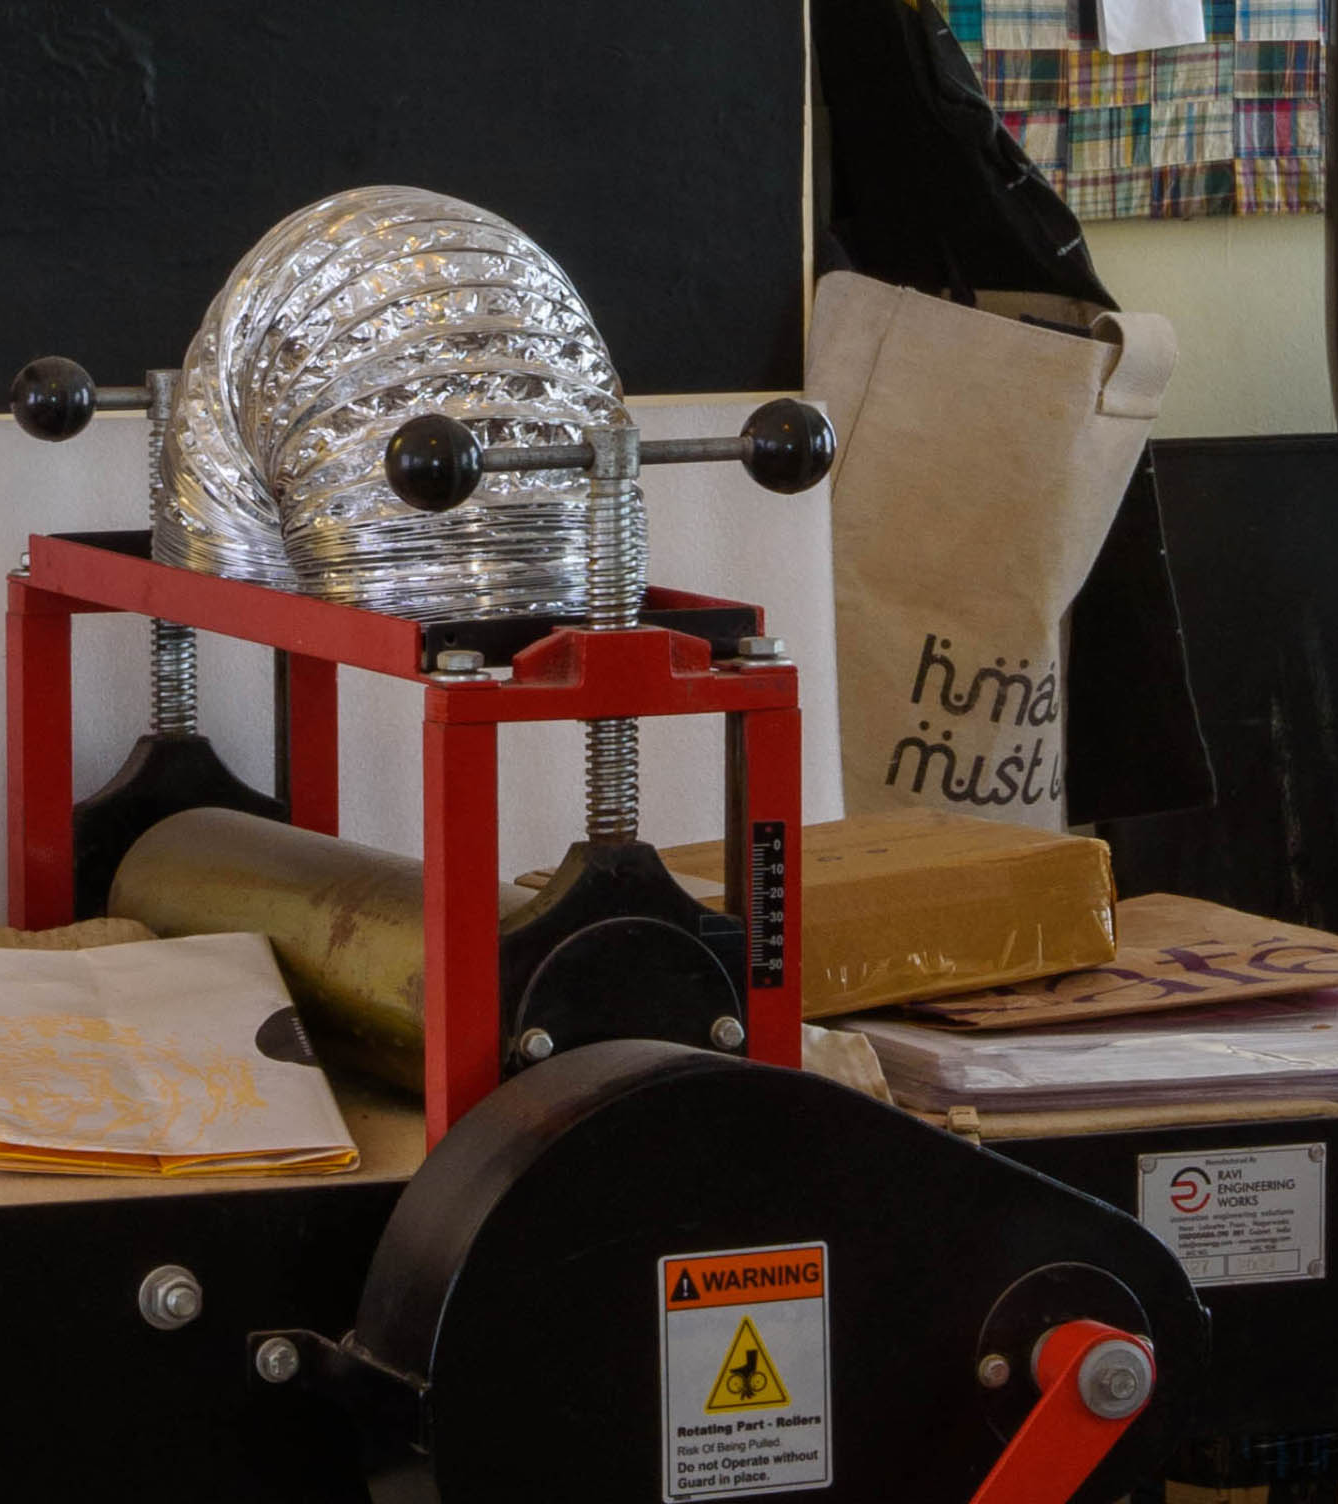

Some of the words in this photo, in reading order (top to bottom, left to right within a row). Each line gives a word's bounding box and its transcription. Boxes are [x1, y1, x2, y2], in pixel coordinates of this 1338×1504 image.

[884, 719, 1046, 808] must
[773, 839, 781, 851] 0
[770, 863, 784, 875] 10
[769, 887, 784, 899] 20
[769, 911, 784, 923] 30
[769, 935, 784, 947] 40
[768, 958, 784, 970] 50
[1217, 1169, 1243, 1181] RAVI
[1217, 1178, 1296, 1194] ENGINEERING
[1217, 1195, 1259, 1208] WORKS
[702, 1262, 820, 1292] WARNING
[677, 1423, 733, 1438] Rotating
[737, 1420, 764, 1432] Part
[776, 1415, 821, 1428] Rollers
[677, 1446, 699, 1456] Risk
[702, 1443, 716, 1454] Of
[717, 1441, 746, 1454] Being
[749, 1437, 781, 1450] Pulled
[677, 1462, 695, 1473] Do
[698, 1459, 718, 1472] not
[721, 1455, 770, 1471] Operate
[773, 1450, 819, 1464] without
[677, 1476, 716, 1489] Guard
[719, 1474, 731, 1485] in
[733, 1471, 770, 1486] place.
